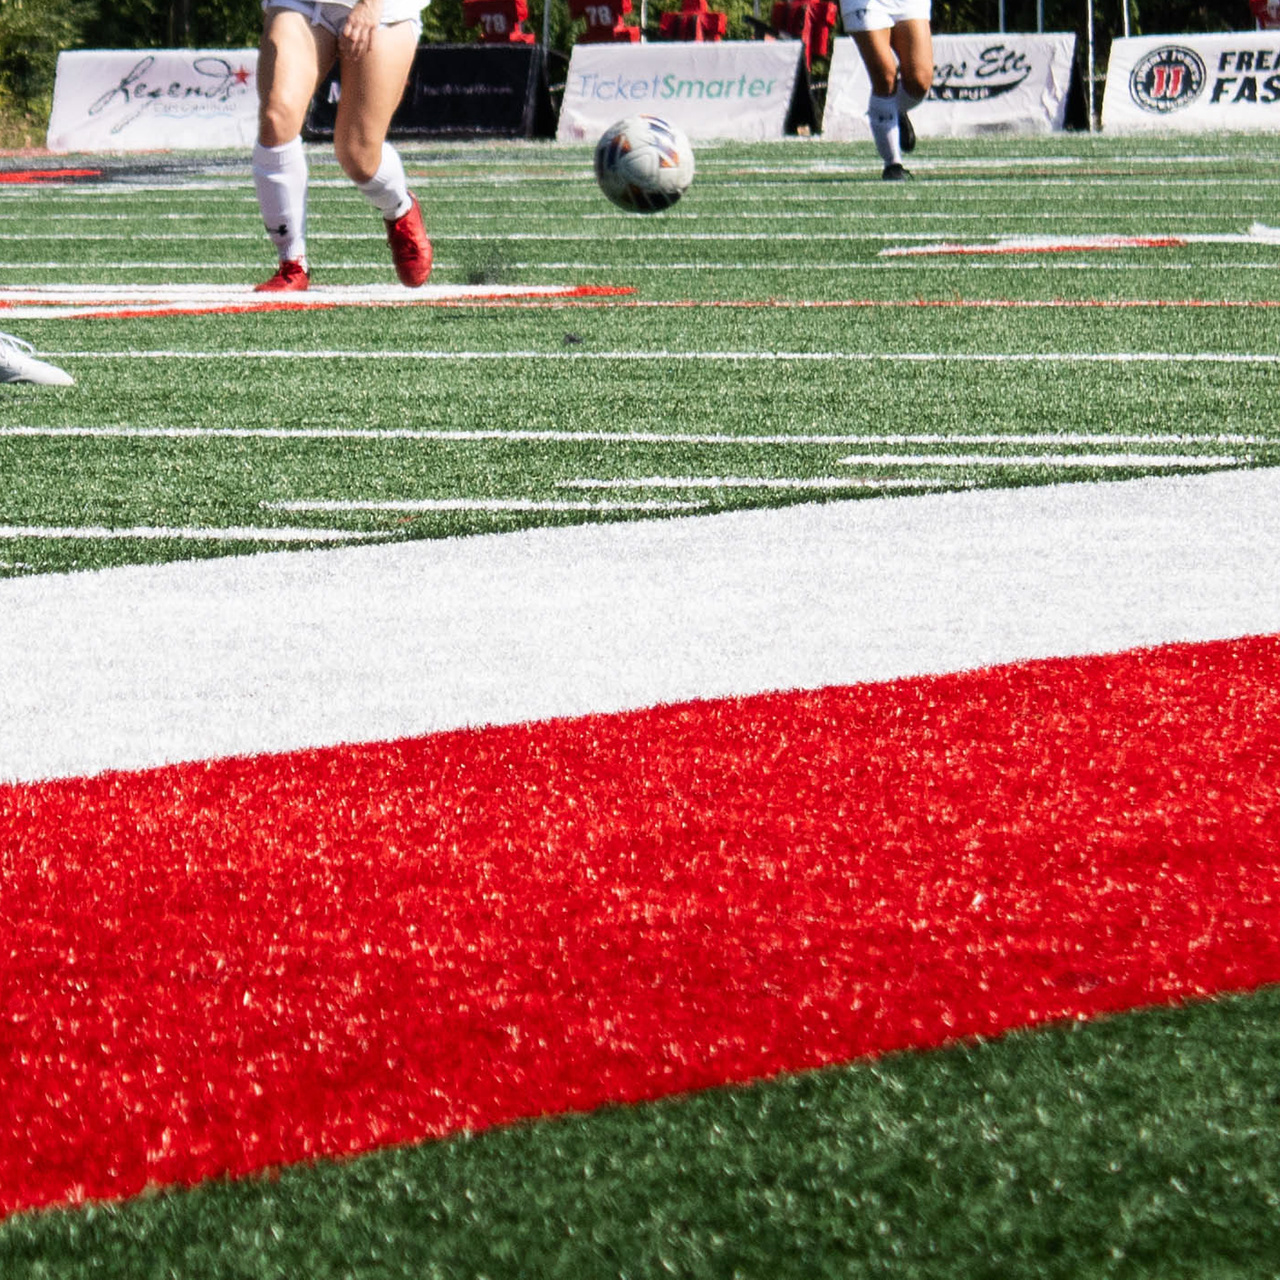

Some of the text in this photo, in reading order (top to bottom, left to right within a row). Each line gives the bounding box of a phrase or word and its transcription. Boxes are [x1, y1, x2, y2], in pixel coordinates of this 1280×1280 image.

[481, 13, 507, 34] 78
[584, 4, 613, 27] 78
[578, 73, 777, 100] TicketSmarter
